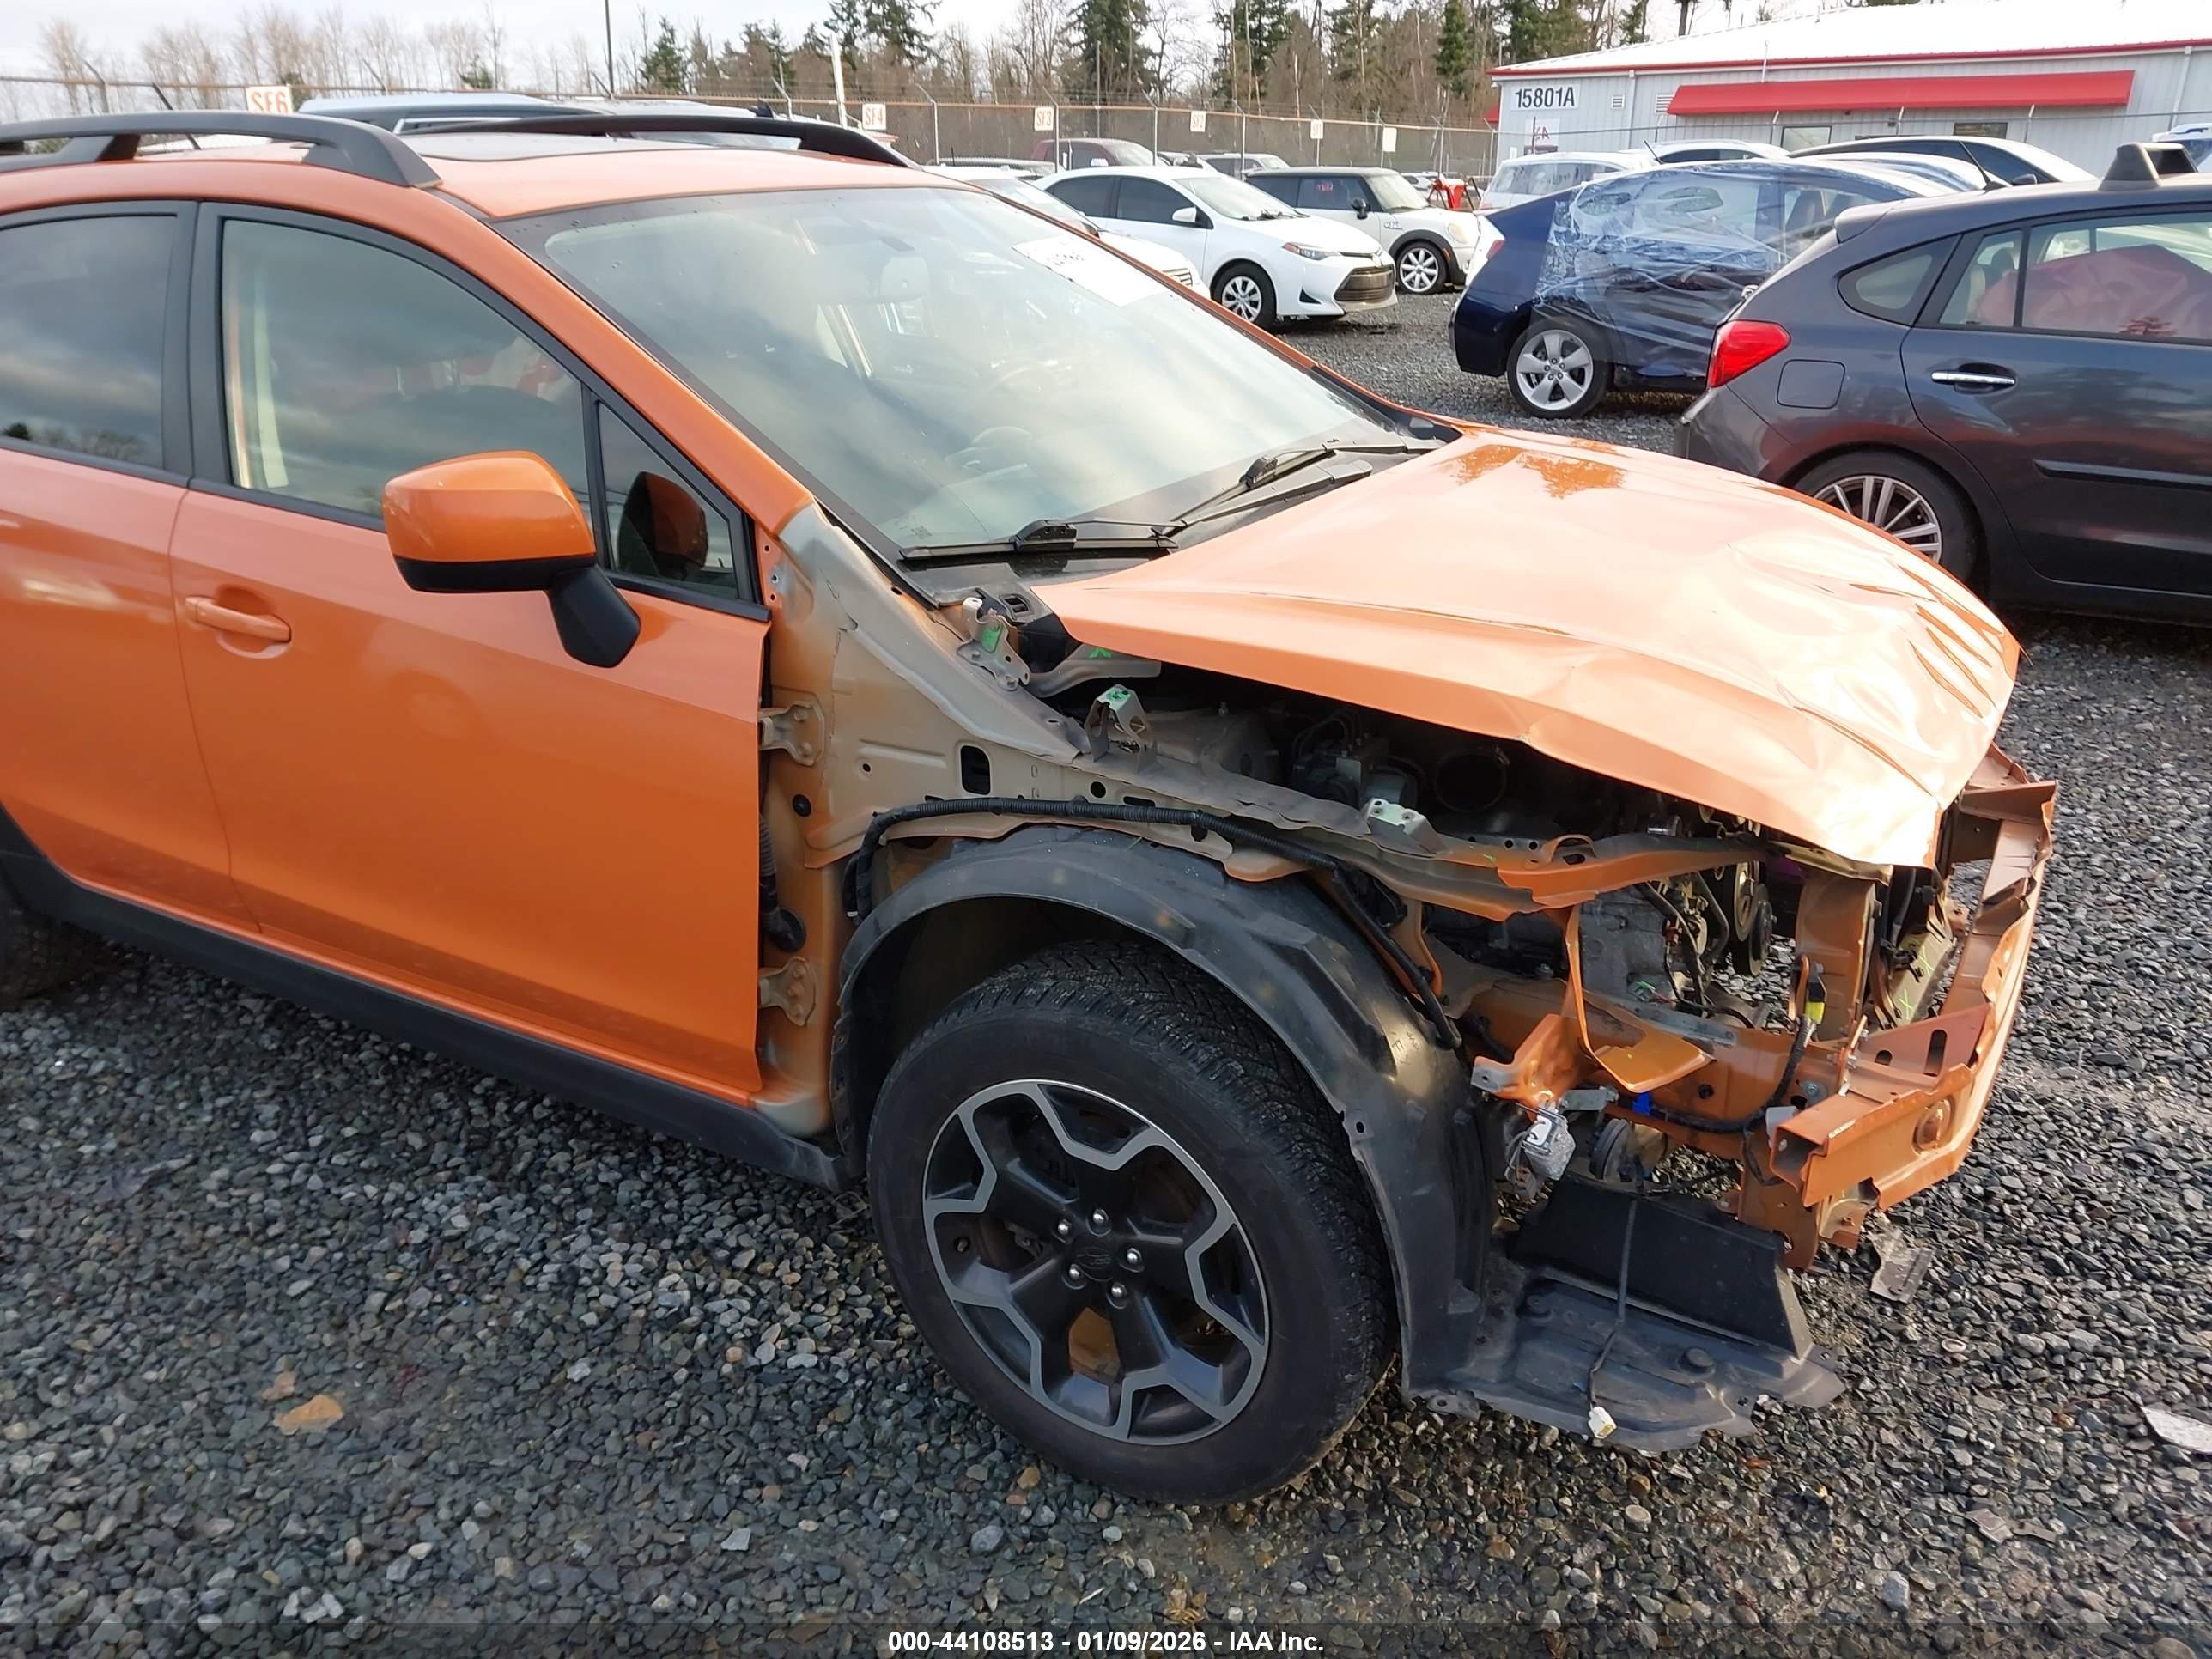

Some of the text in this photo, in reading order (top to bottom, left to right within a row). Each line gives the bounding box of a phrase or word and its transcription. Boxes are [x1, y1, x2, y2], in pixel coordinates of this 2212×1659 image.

[1515, 87, 1575, 108] 15801A
[865, 107, 884, 126] SF4
[1037, 111, 1052, 126] SF3
